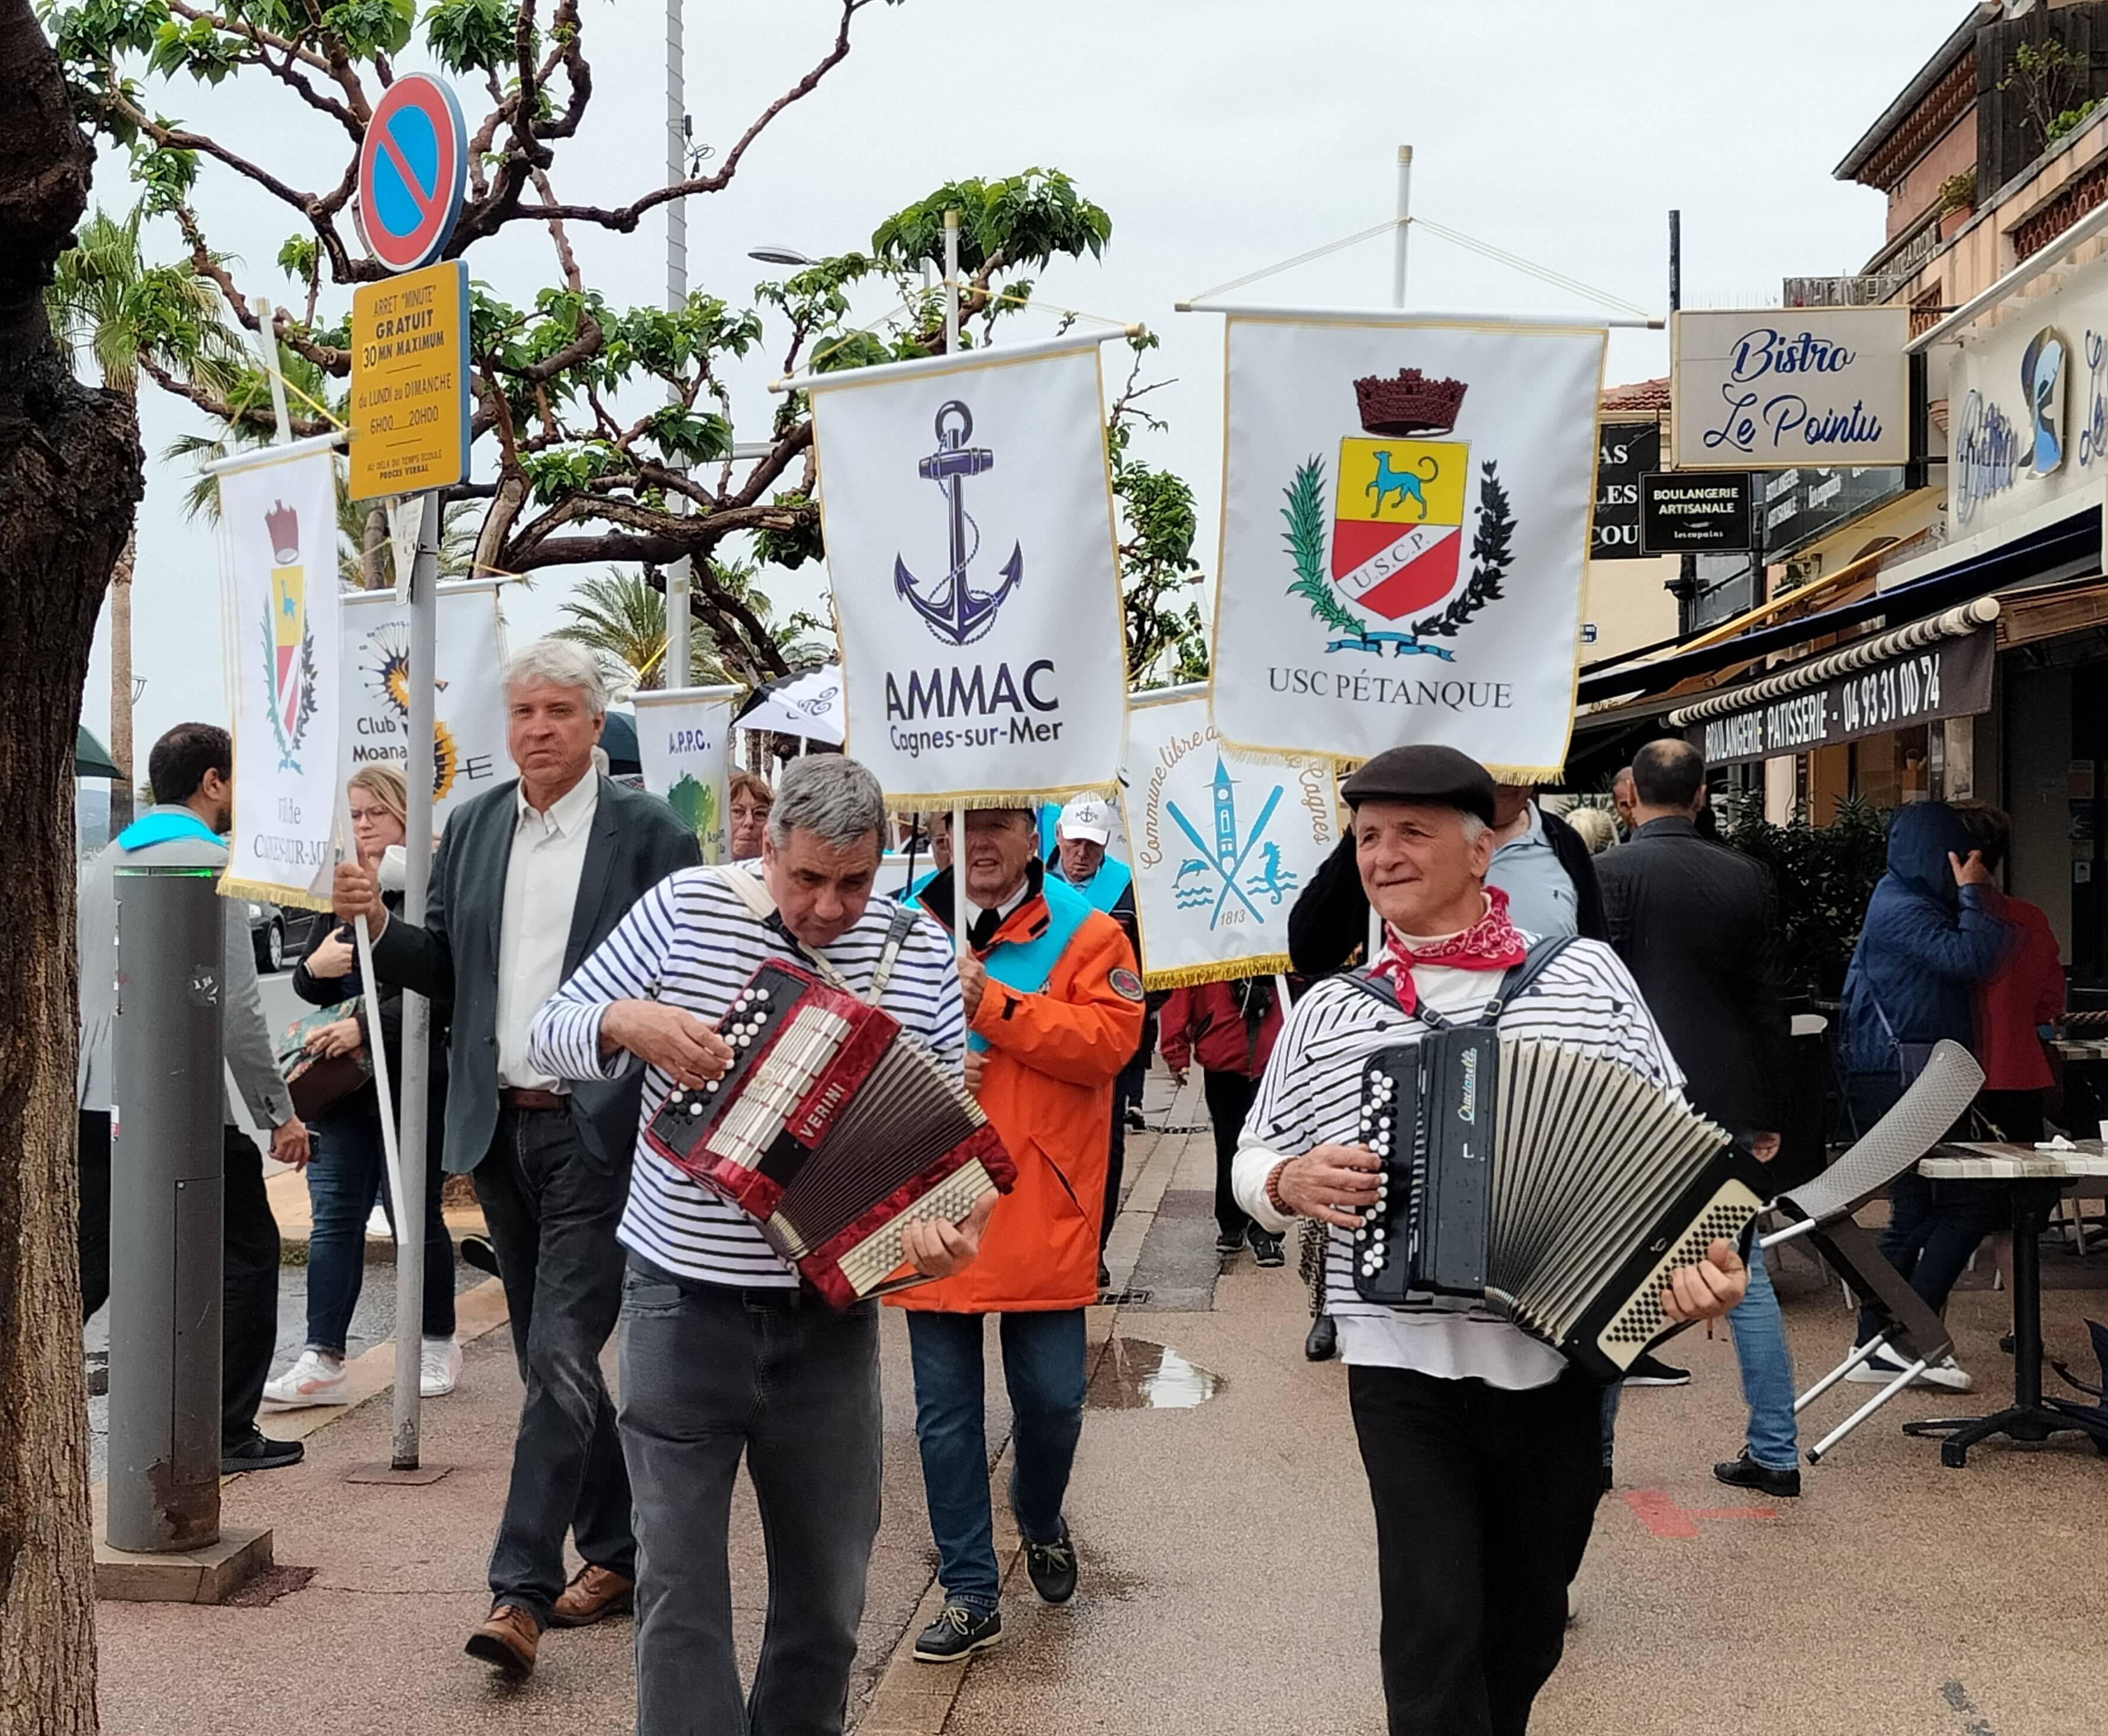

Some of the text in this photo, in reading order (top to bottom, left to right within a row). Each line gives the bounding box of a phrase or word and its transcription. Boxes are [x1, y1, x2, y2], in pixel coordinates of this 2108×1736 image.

[373, 295, 398, 317] ARRET
[376, 309, 433, 340] GRATUIT
[363, 346, 376, 369] 30
[397, 331, 444, 357] MAXIMUM
[1730, 329, 1856, 383] Bistro
[359, 373, 452, 408] du LUNDI au DIMANCHE
[1703, 383, 1883, 453] Le Pointu
[1653, 488, 1739, 500] BOULANGERIE
[1658, 502, 1735, 515] ARTISANALE
[886, 659, 1059, 721] AMMAC
[1269, 667, 1514, 712] USC PÉTANQUE
[1705, 710, 1763, 763] BOULANGERIE
[1767, 691, 1828, 750] PATISSERIE
[1842, 677, 1859, 733] 04
[1861, 673, 1878, 727] 93
[1880, 667, 1895, 722] 31
[1899, 660, 1919, 717] 00
[1920, 652, 1940, 711] 74
[357, 715, 396, 735] Club
[890, 716, 1063, 759] Cagnes-sur-Mer
[353, 744, 407, 763] Moana
[1140, 766, 1168, 871] Commune
[1159, 731, 1203, 768] libre
[1220, 909, 1245, 927] 1813
[799, 1082, 845, 1137] VERINI
